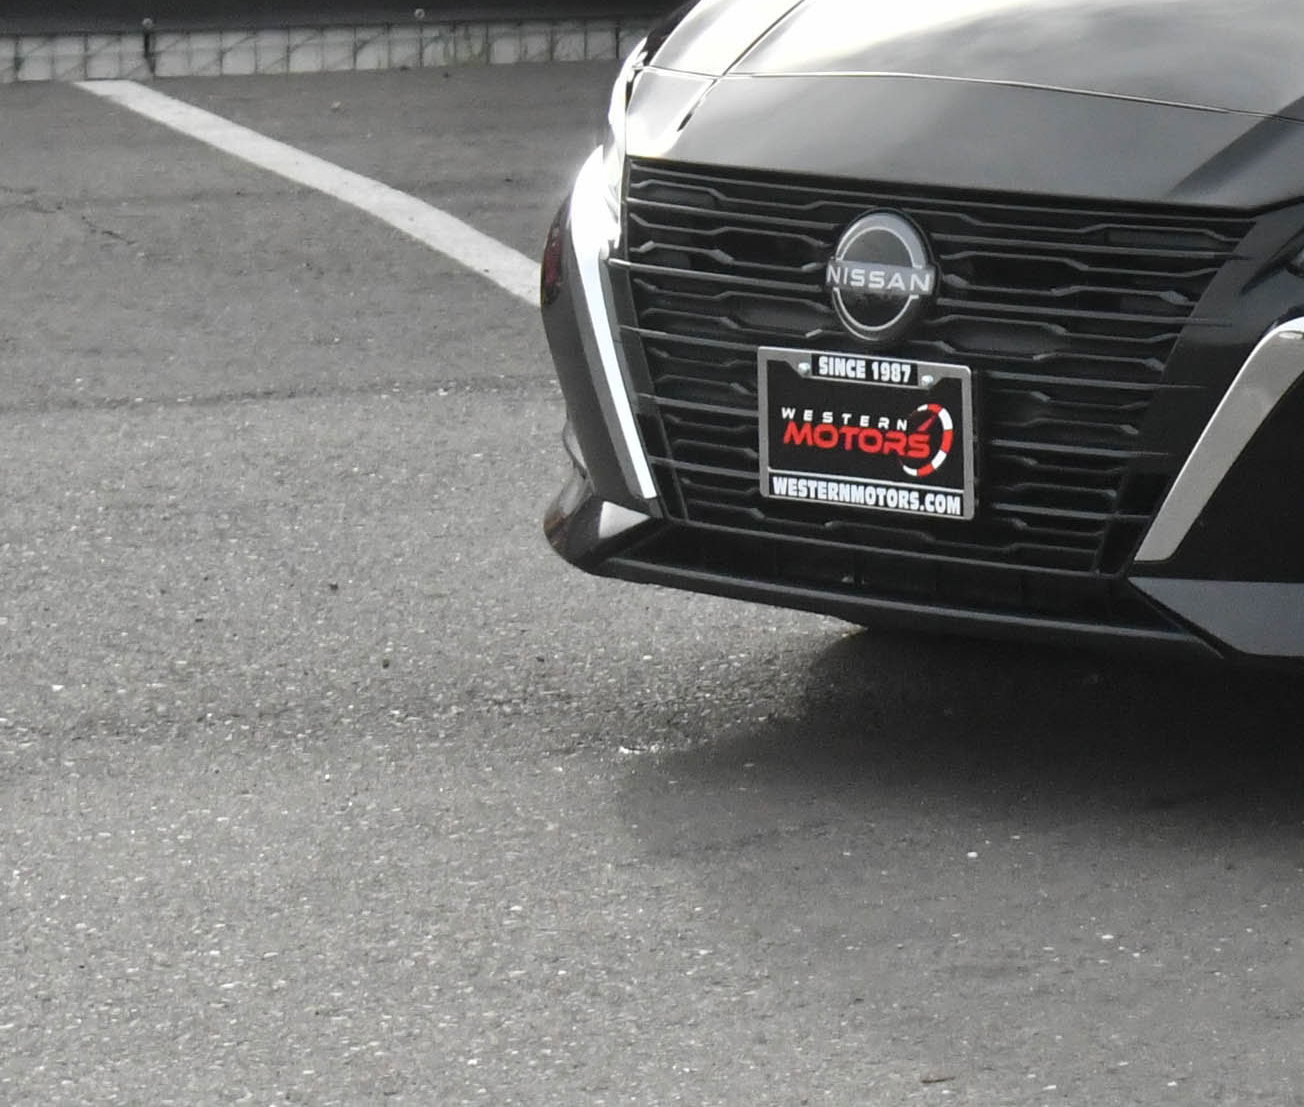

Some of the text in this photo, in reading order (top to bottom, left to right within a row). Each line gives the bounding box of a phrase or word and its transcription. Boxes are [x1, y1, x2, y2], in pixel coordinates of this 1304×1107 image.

[826, 264, 930, 291] NISSAN
[818, 355, 911, 383] SINCE 1987
[782, 408, 907, 431] WESTERN
[784, 418, 932, 458] MOTORS
[772, 476, 962, 515] WESTERNMOTORS.COM
